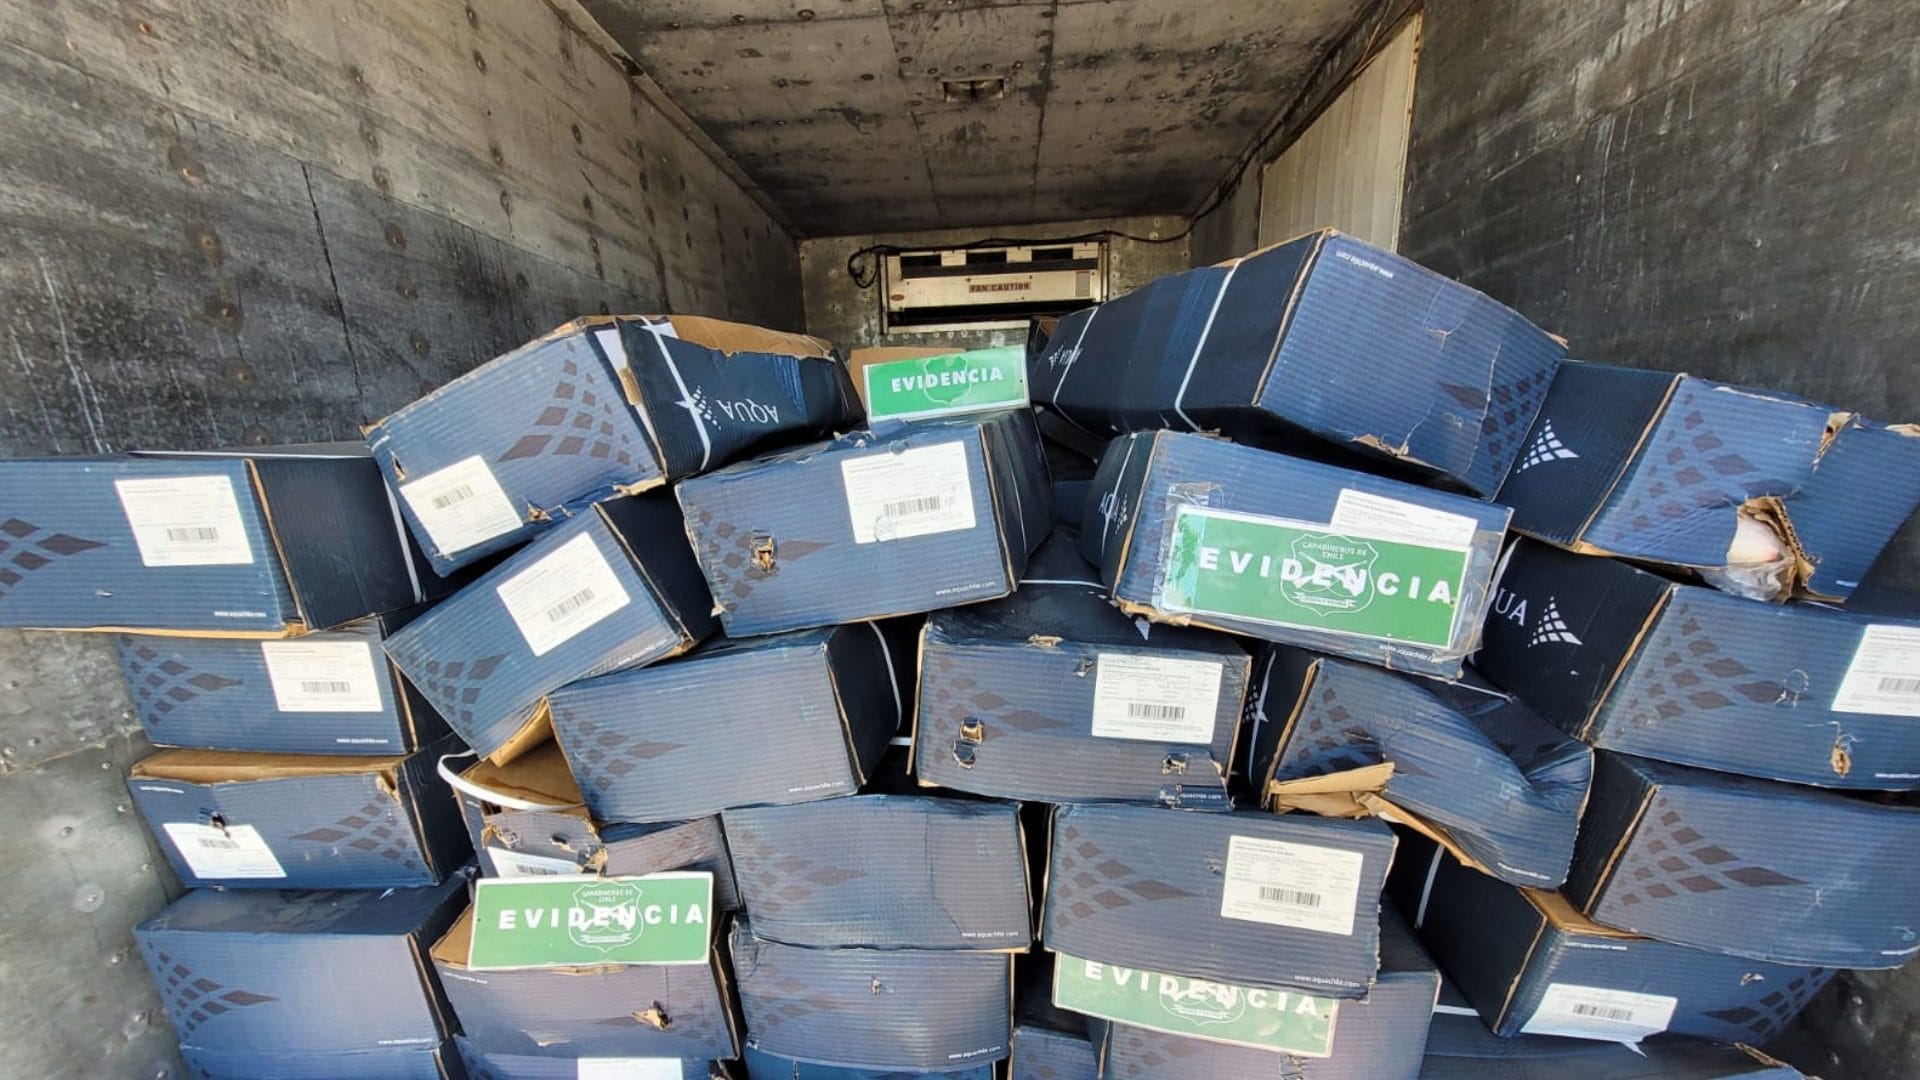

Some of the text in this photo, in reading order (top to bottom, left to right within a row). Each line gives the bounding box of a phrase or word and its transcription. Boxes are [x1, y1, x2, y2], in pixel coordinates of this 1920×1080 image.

[970, 281, 1030, 293] FAN CAUTION
[891, 367, 1004, 393] EVIDENCIA
[716, 398, 779, 424] AQUA
[1302, 542, 1355, 554] CARABINEROS
[1322, 552, 1345, 560] CHILE
[1199, 547, 1451, 605] EVIDENCIA
[498, 904, 704, 931] EVIDENCIA
[1085, 960, 1317, 1016] EVIDENCIA
